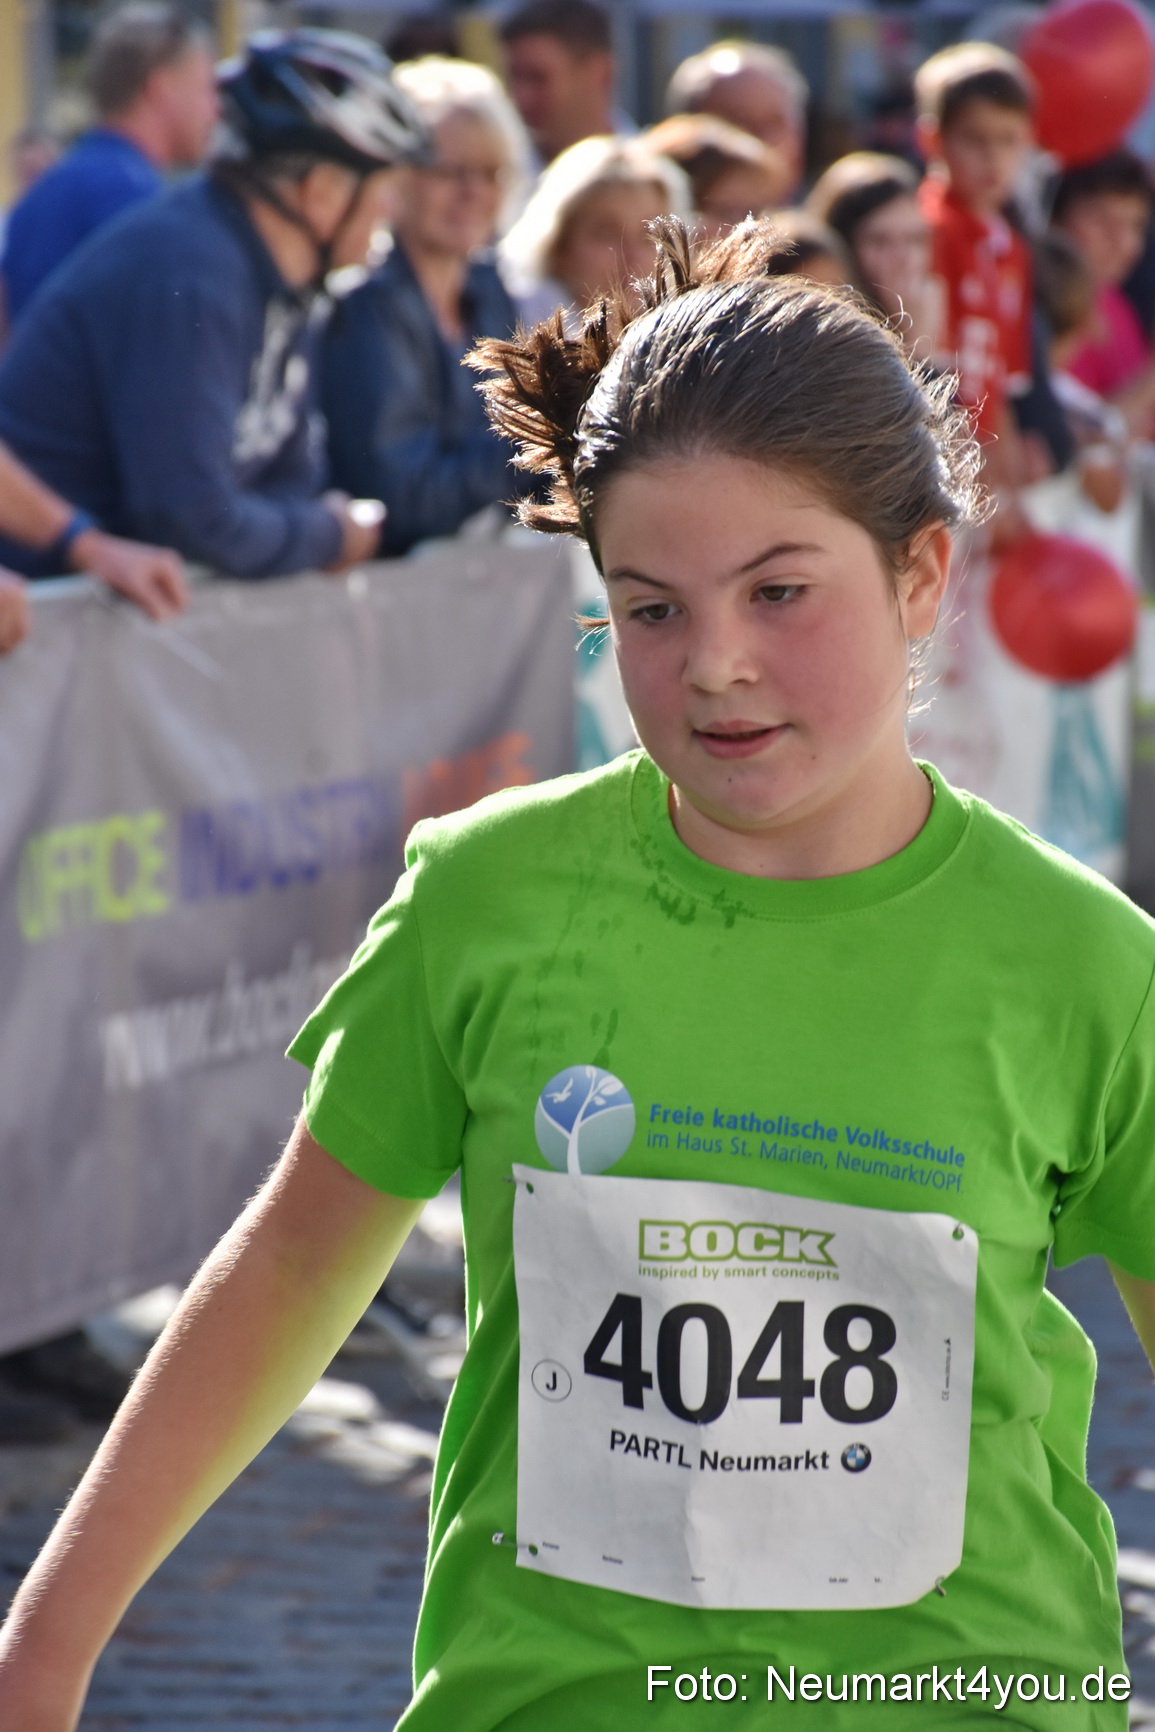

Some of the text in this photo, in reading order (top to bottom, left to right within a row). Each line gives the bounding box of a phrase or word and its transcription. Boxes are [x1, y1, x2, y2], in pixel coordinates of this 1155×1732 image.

[647, 1129, 669, 1148] im
[677, 1132, 722, 1153] Haus
[730, 1136, 752, 1157] St.
[759, 1140, 828, 1170] Marien,
[650, 1103, 965, 1168] Freie katholische Volksschule
[638, 1219, 839, 1268] BOCK
[638, 1264, 839, 1281] inspired by smart concepts
[583, 1292, 898, 1425] 4048
[545, 1370, 557, 1392] J
[610, 1429, 692, 1469] PARTL
[700, 1449, 830, 1472] Neumarkt
